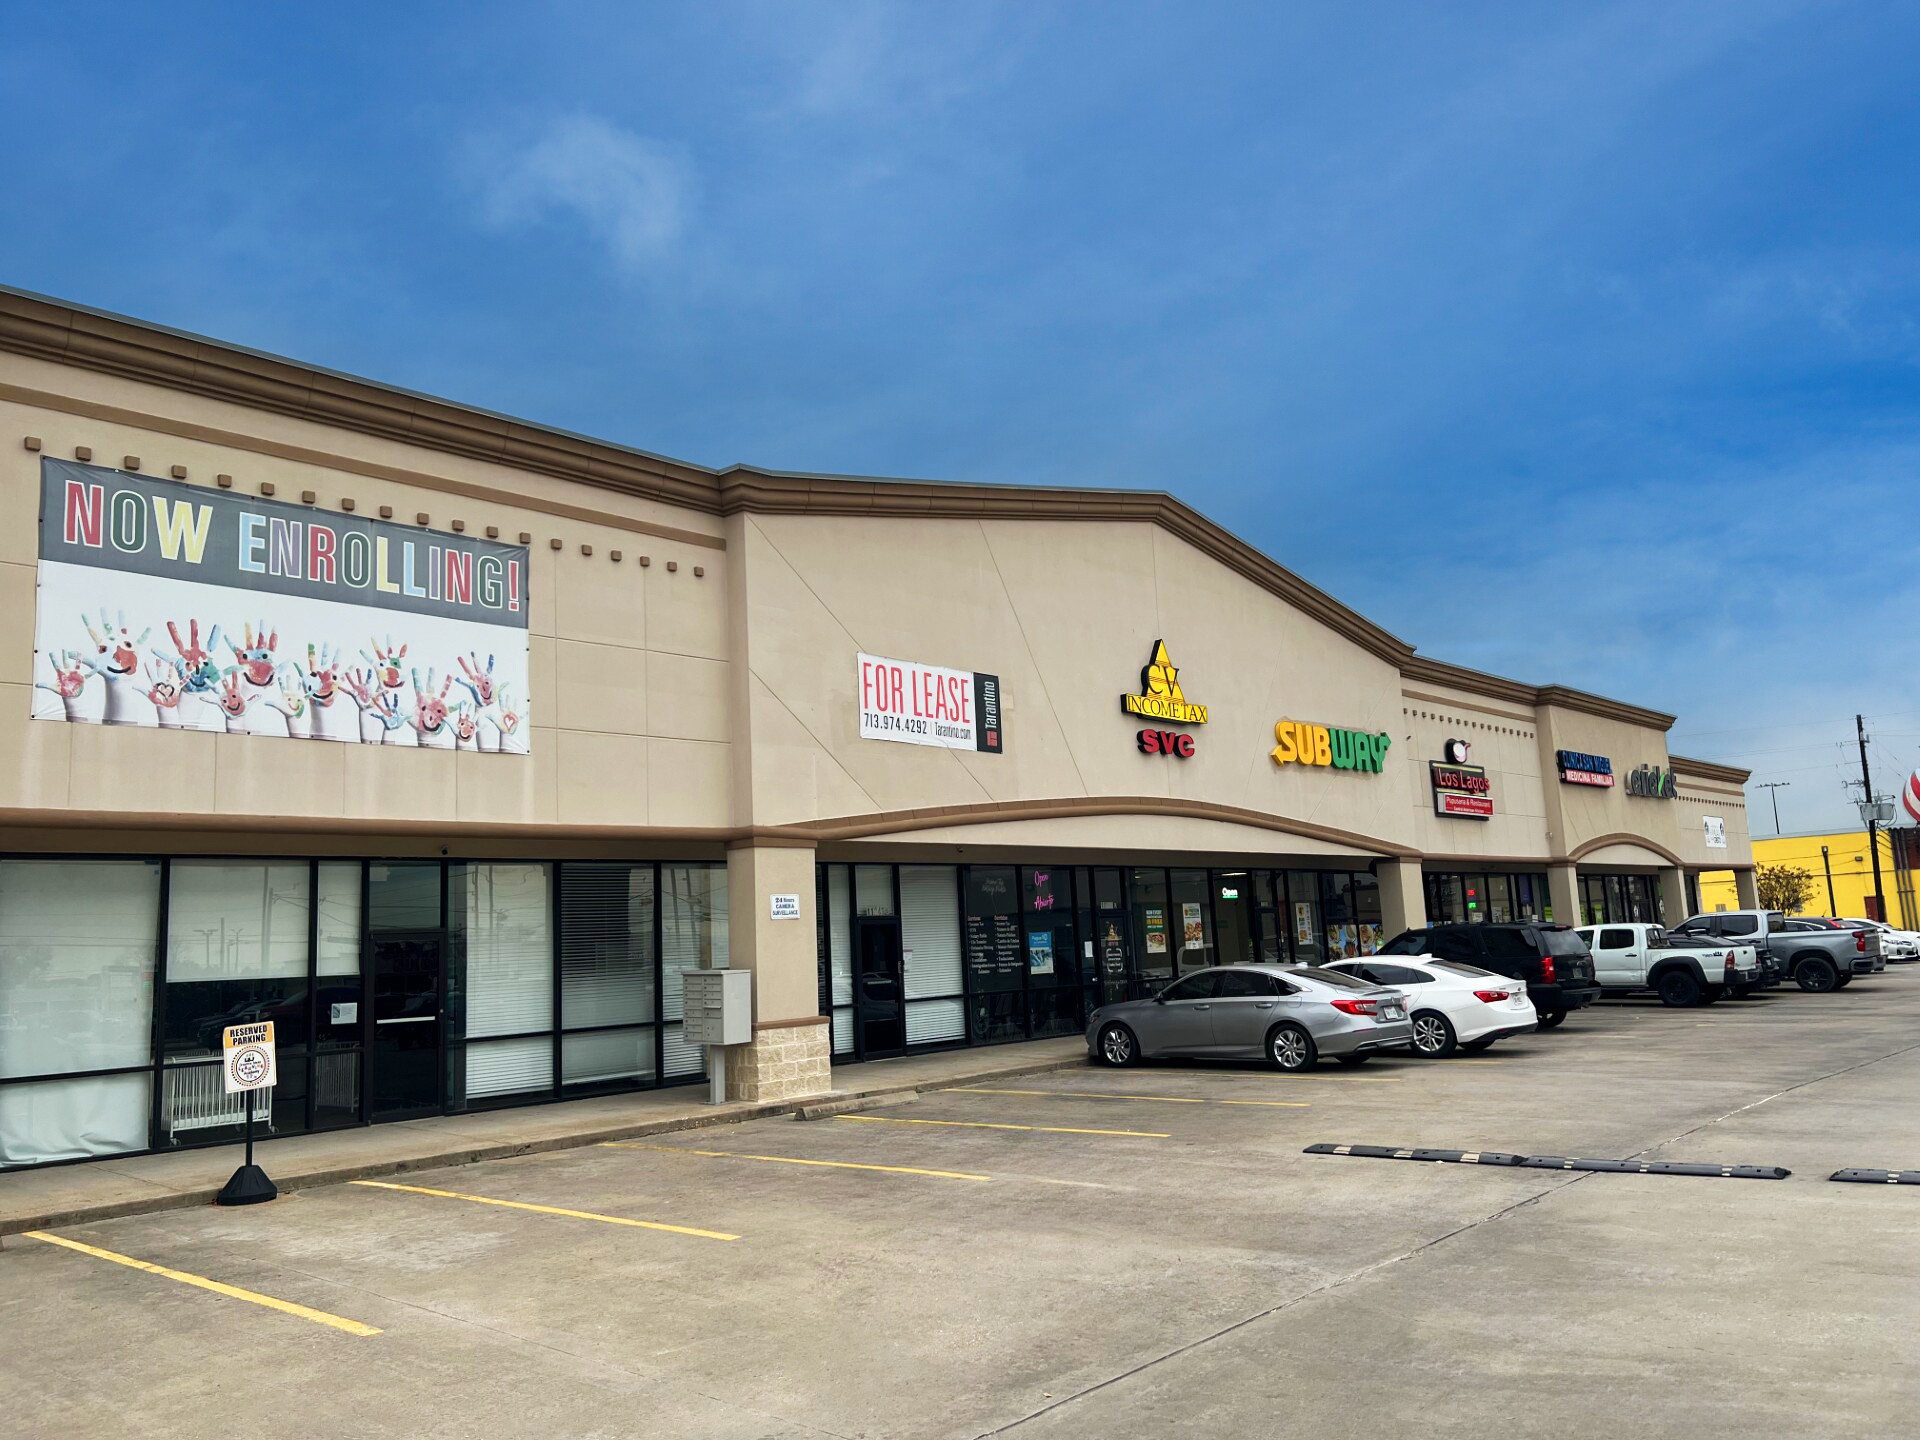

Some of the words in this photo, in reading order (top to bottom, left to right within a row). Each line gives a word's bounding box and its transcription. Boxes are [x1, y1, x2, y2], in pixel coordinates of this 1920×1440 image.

[63, 479, 213, 565] NOW
[238, 512, 521, 612] ENROLLING!
[863, 662, 904, 714] FOR
[912, 670, 970, 723] LEASE
[1147, 664, 1179, 696] CV
[984, 681, 997, 729] Tarantino
[1127, 695, 1180, 718] INCOME
[1180, 703, 1207, 722] TAX
[864, 712, 927, 735] 713.974.4292
[934, 721, 971, 740] Tarantino.com
[1138, 729, 1195, 758] SVC
[1271, 720, 1391, 773] SUBWAY
[1438, 768, 1458, 786] Los
[1460, 770, 1490, 793] Lagos
[1566, 769, 1591, 784] MEDICINA
[1591, 773, 1613, 787] FAMILIAR
[1035, 870, 1049, 887] Open
[1222, 887, 1238, 897] Open
[230, 1025, 267, 1037] RESERVED
[233, 1033, 266, 1046] PARKING
